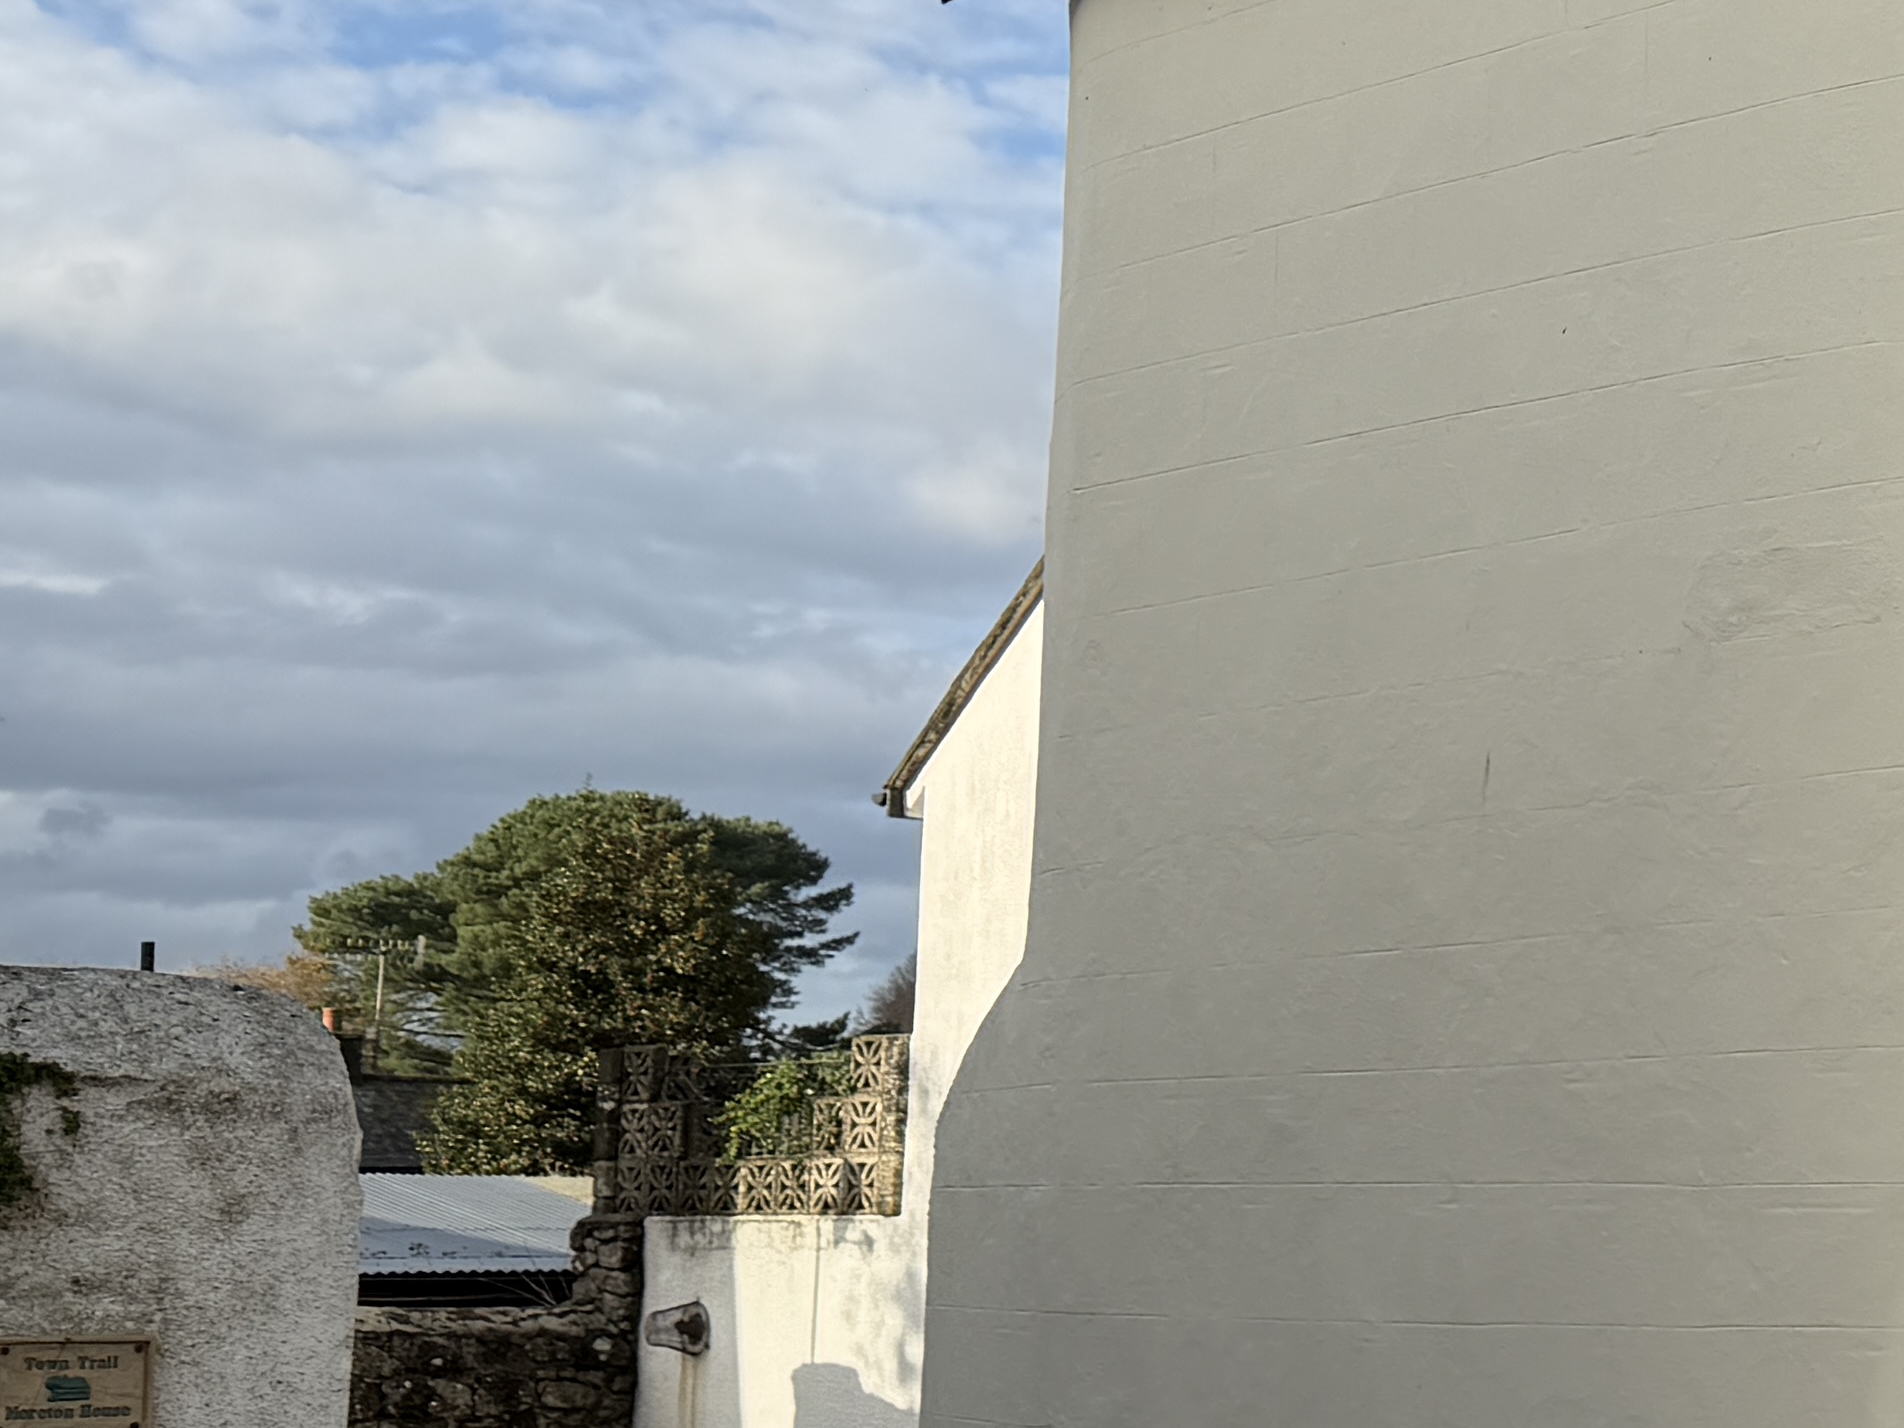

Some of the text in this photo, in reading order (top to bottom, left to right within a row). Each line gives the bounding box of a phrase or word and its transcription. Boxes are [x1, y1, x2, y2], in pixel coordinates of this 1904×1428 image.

[24, 1355, 119, 1371] Town Trail
[79, 1404, 131, 1418] House
